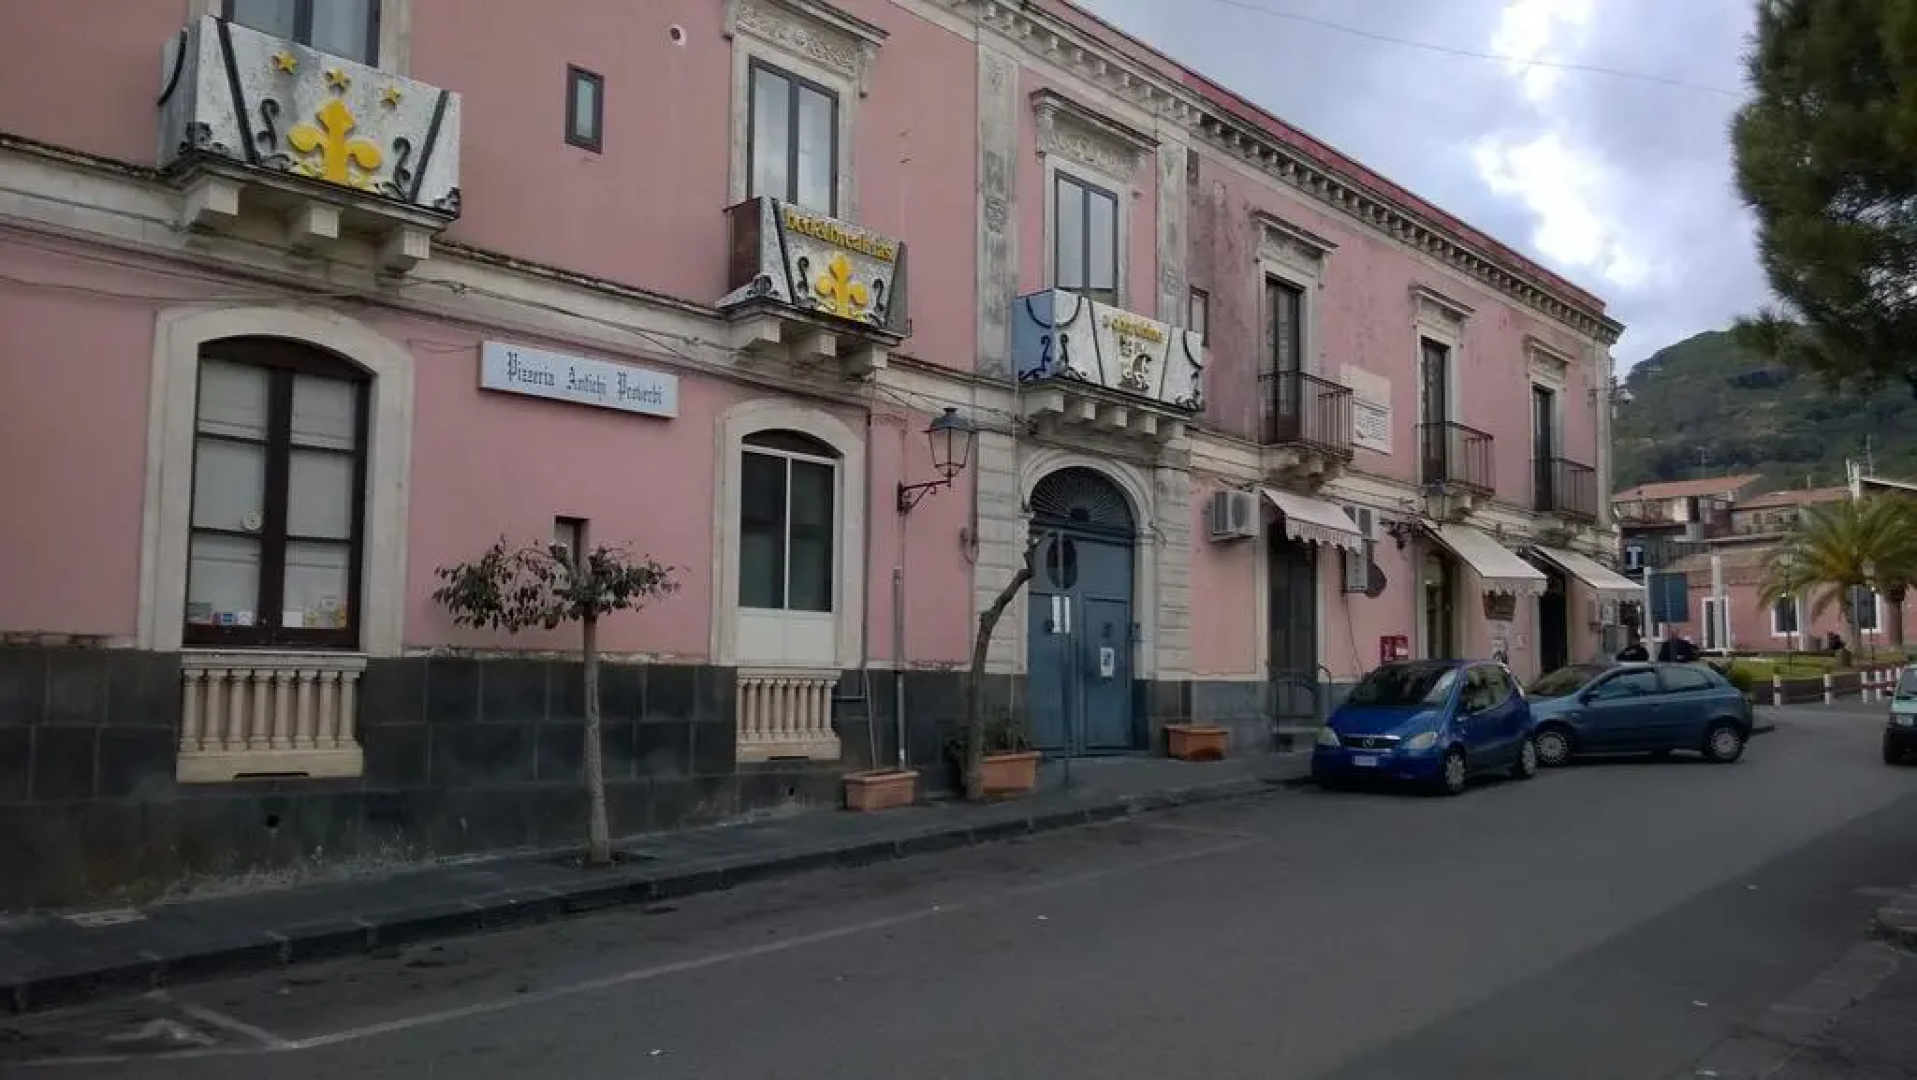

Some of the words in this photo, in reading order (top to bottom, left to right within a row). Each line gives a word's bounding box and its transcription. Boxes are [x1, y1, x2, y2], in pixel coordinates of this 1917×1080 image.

[506, 351, 555, 386] Pizzeria
[566, 366, 607, 398] Antichi
[617, 371, 663, 405] Proverbi
[1626, 545, 1643, 570] T
